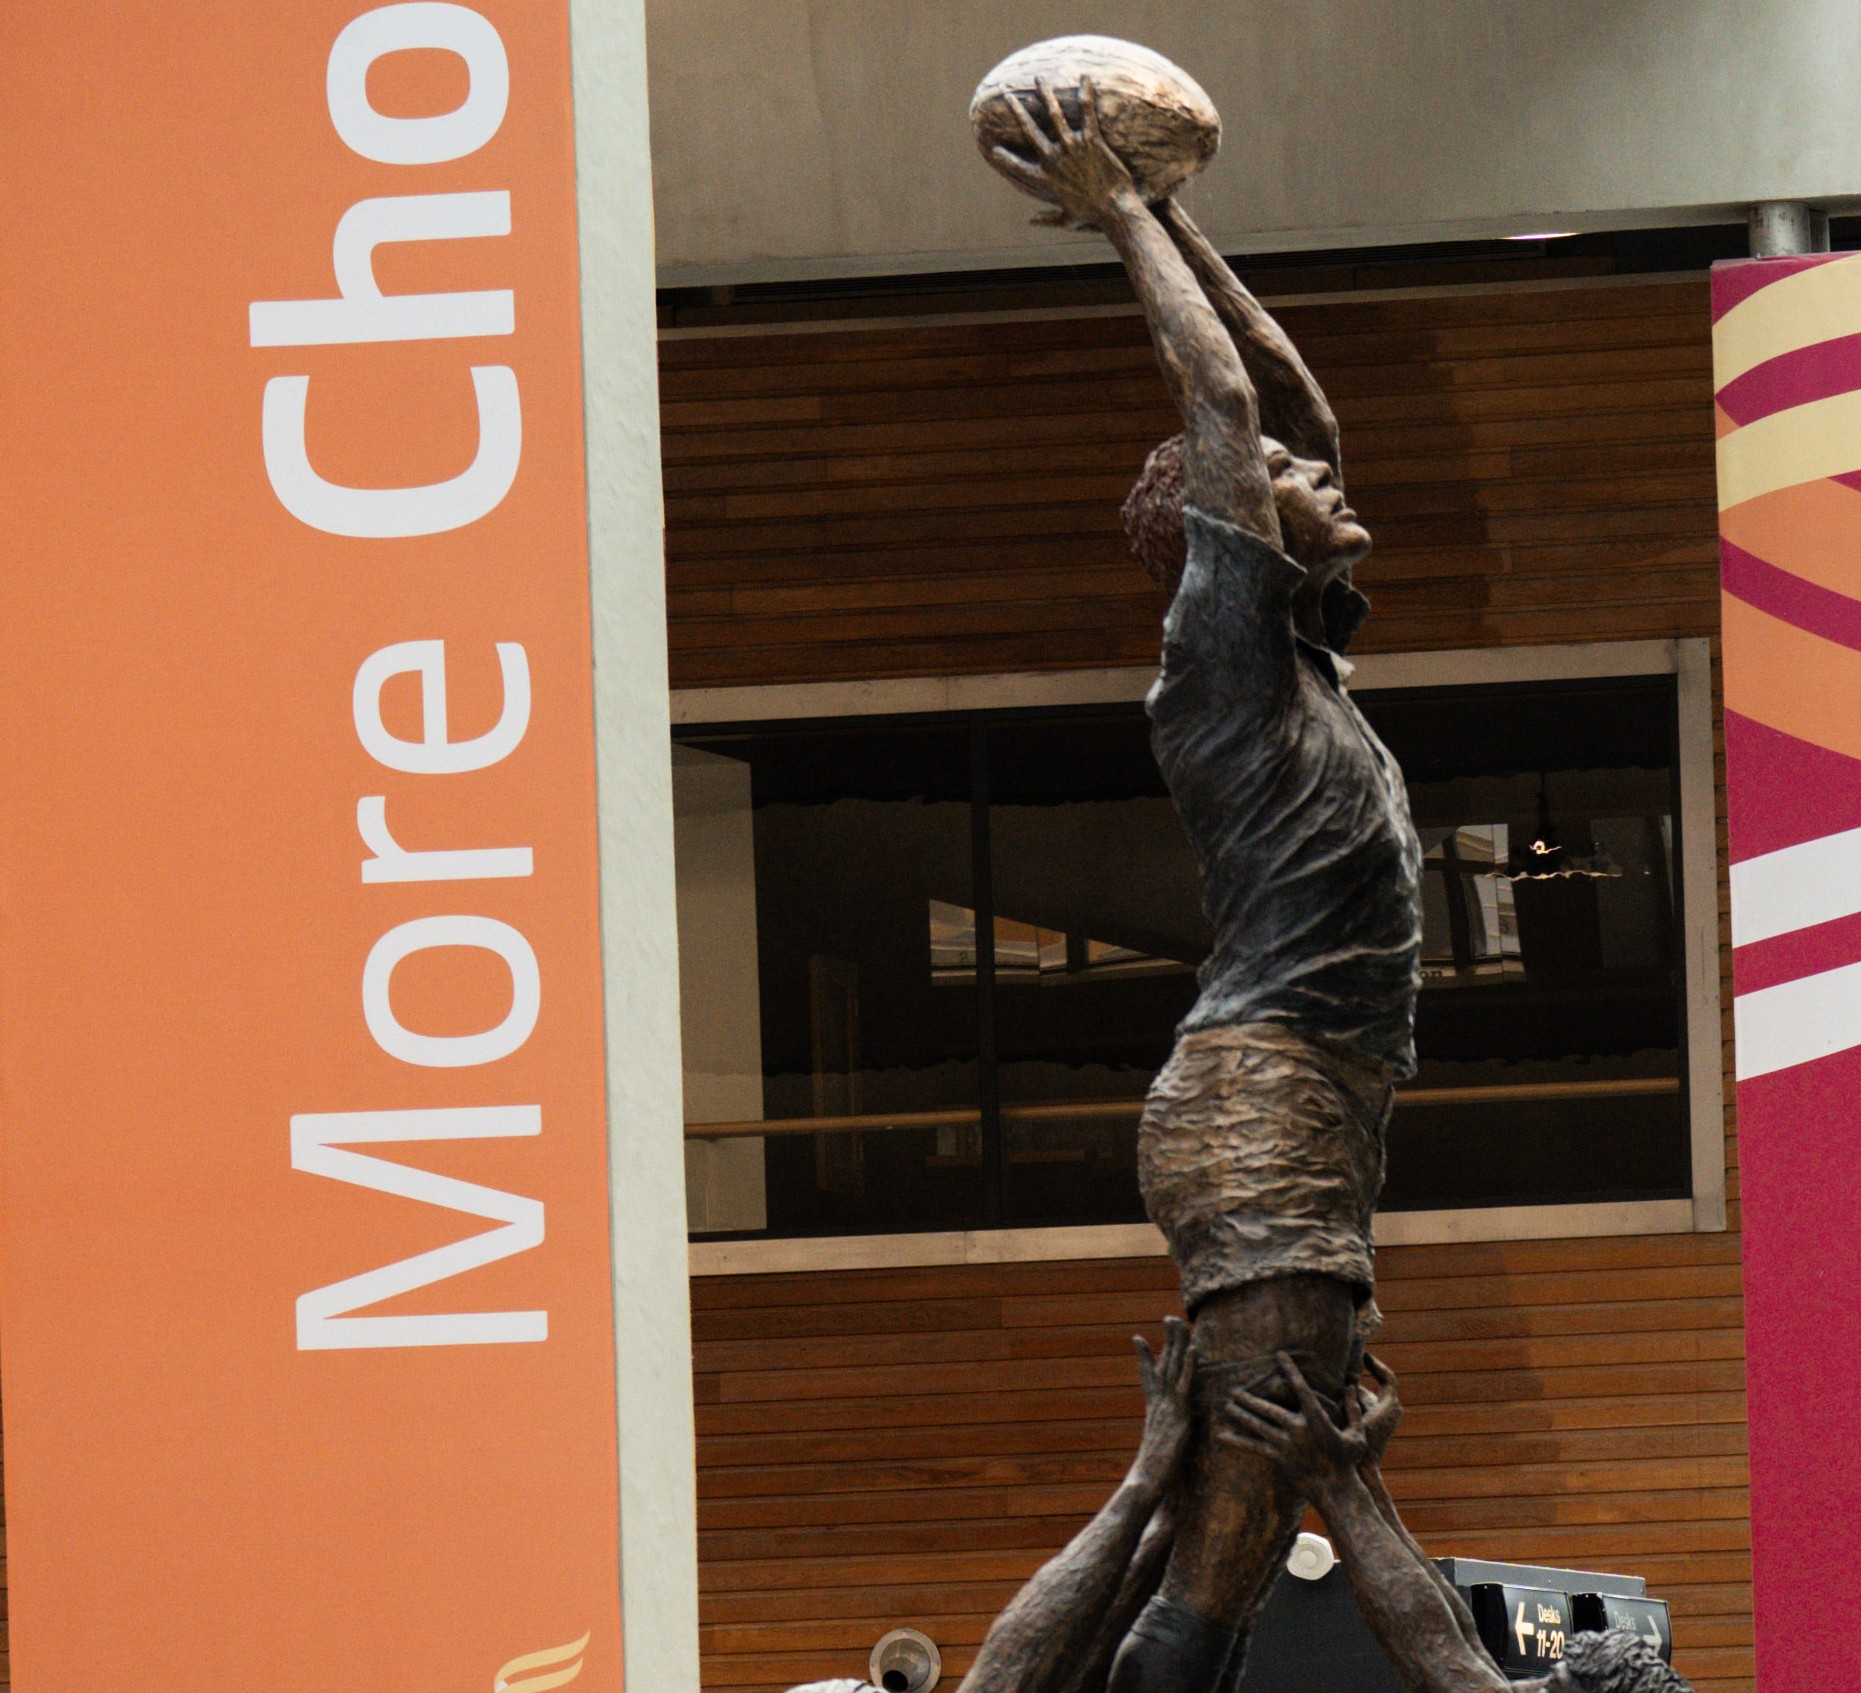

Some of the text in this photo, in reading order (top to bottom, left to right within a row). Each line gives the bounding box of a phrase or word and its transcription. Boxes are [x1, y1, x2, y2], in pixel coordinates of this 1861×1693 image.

[291, 640, 549, 1351] More
[1537, 1603, 1561, 1624] Desks
[1614, 1611, 1636, 1631] Desks
[1536, 1628, 1565, 1659] 11-20
